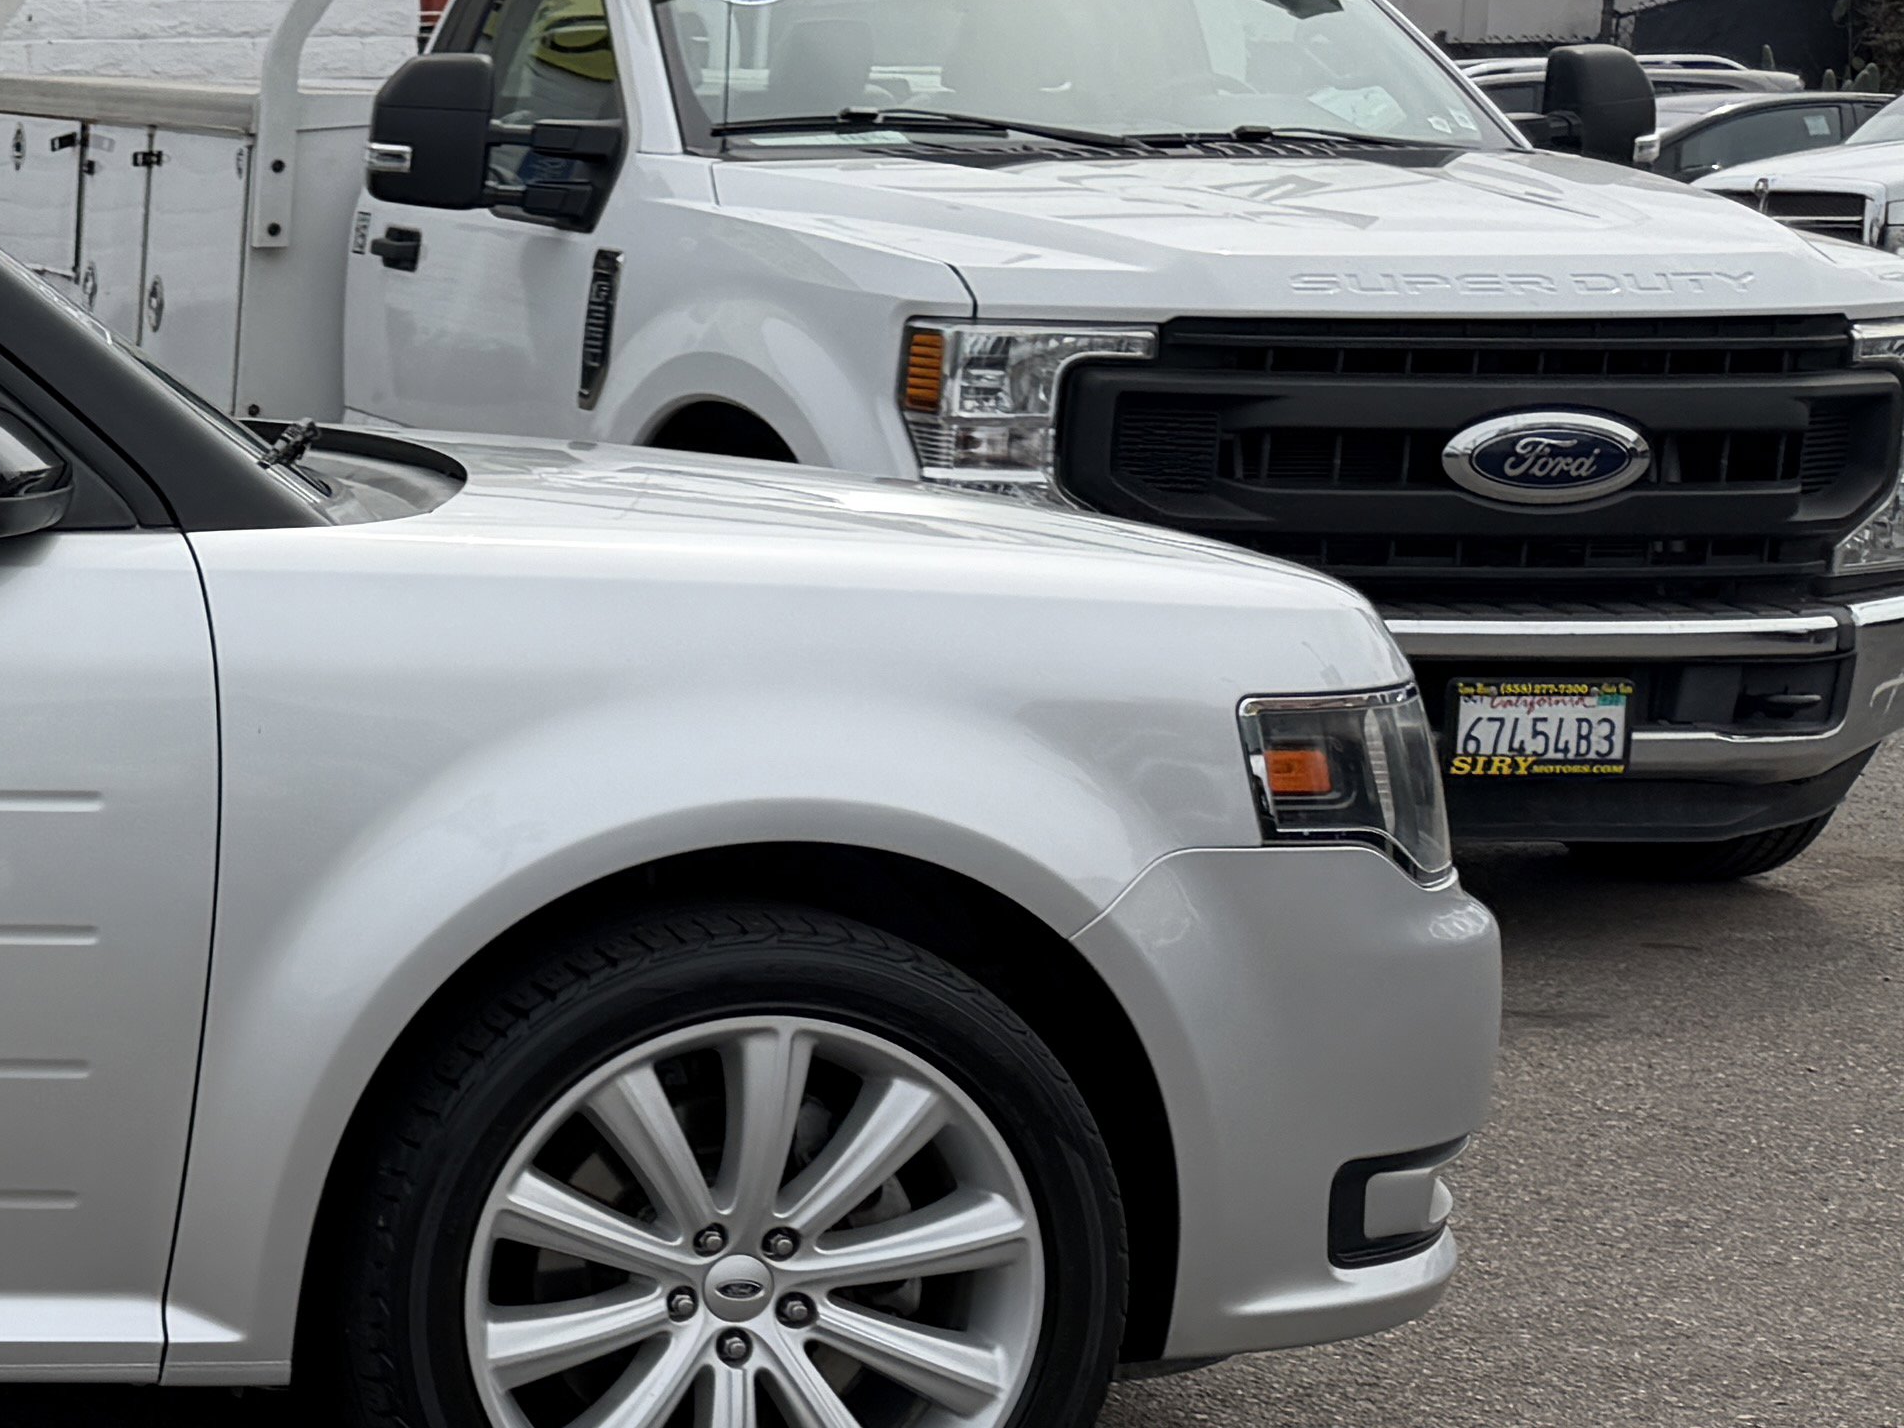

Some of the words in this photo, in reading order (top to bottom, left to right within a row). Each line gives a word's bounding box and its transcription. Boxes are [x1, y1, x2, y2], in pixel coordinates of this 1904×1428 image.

[1291, 272, 1557, 296] SUPER
[1571, 270, 1756, 295] DUTY
[1503, 435, 1601, 478] Ford
[1462, 717, 1616, 758] 67454B3
[1450, 755, 1537, 775] SIRY
